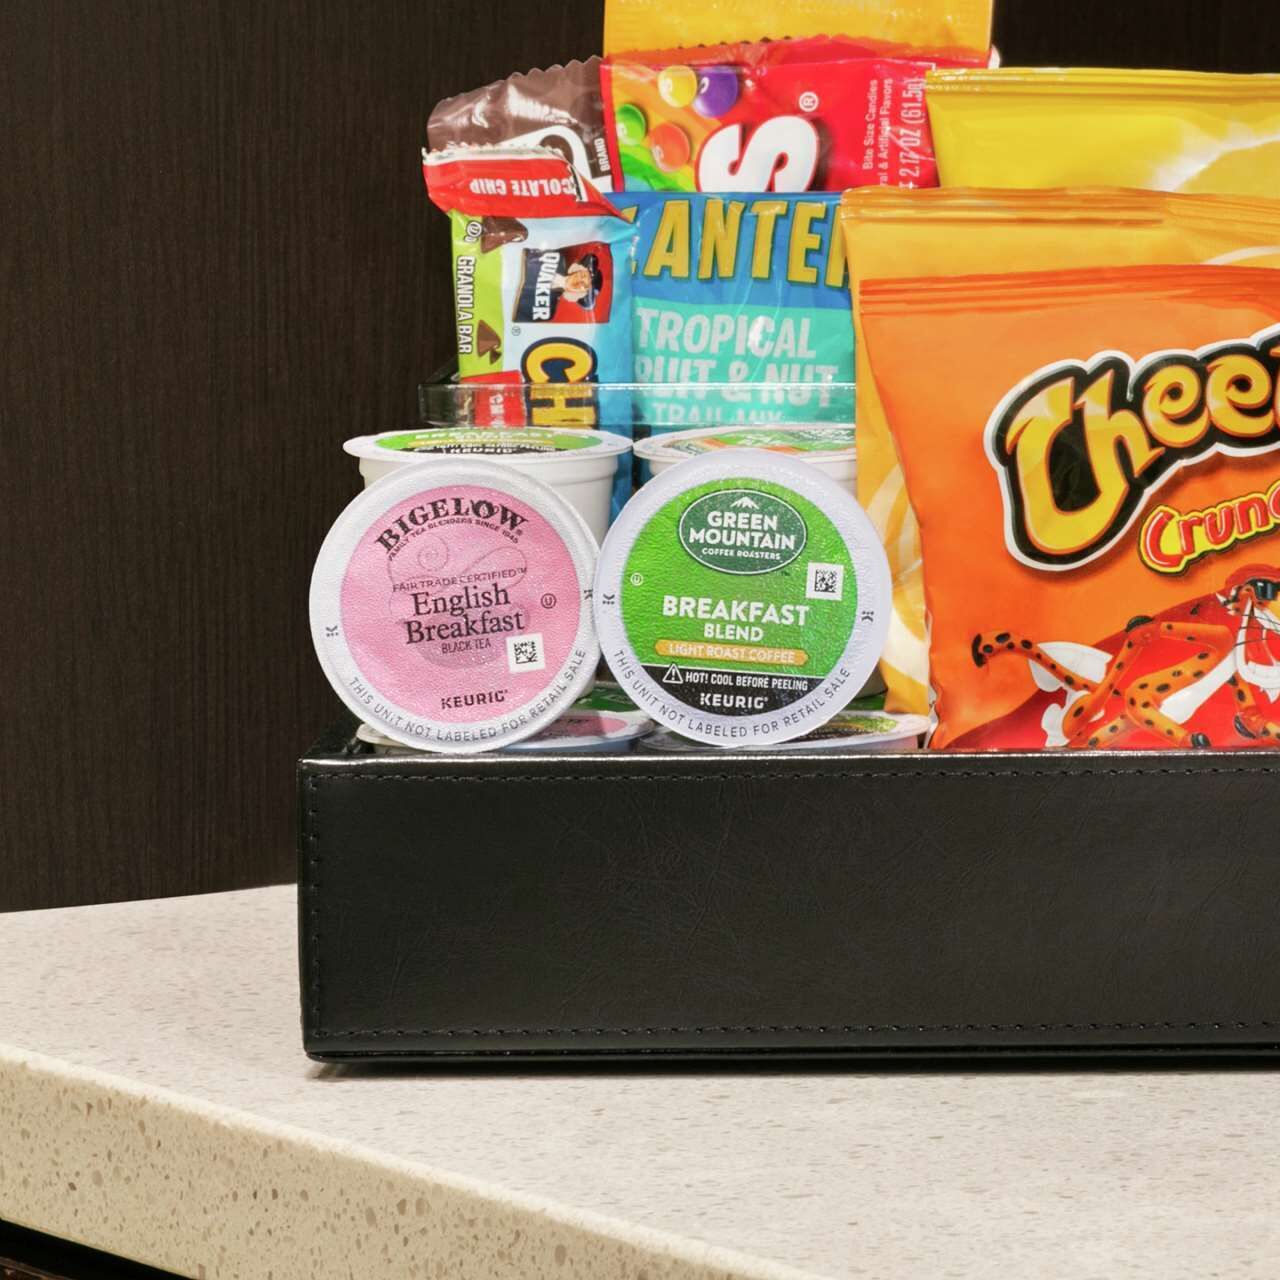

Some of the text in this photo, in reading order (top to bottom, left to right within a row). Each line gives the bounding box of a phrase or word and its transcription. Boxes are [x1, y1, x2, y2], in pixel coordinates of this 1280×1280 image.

[880, 79, 893, 114] Flavors
[862, 80, 878, 170] Bite Size Candies
[594, 138, 611, 172] BRAND
[469, 178, 575, 197] COLATE CHIP
[532, 252, 561, 320] QUAKER
[456, 256, 477, 354] GRANOLA BAR
[635, 307, 817, 359] TROPICAL
[635, 355, 839, 409] RUIT & NUT
[375, 497, 528, 553] BIGELOW
[475, 520, 499, 531] SINCE
[707, 510, 778, 531] GREEN
[688, 527, 796, 550] MOUNTAIN
[702, 547, 782, 561] COFFEE ROASTERS
[393, 582, 418, 593] FAIR
[421, 577, 458, 589] TRADE
[410, 583, 511, 618] English
[662, 595, 811, 627] BREAKFAST
[404, 611, 525, 645] Breakfast
[704, 623, 764, 642] BLEND
[441, 638, 492, 655] BLACK TEA
[669, 644, 796, 663] LIGHT ROAST COFFEE
[349, 677, 372, 706] THIS
[374, 705, 404, 728] UNIT
[404, 721, 432, 739] NOT
[436, 727, 497, 742] LABELED
[502, 714, 528, 735] FOR
[530, 683, 568, 719] RETAIL
[565, 648, 586, 681] SALE
[613, 650, 633, 680] THIS
[632, 680, 658, 707] UNIT
[659, 704, 684, 725] NOT
[688, 718, 748, 738] LABELED
[753, 721, 780, 736] FOR
[783, 696, 825, 726] RETAIL
[825, 667, 850, 699] SALE
[686, 672, 809, 691] HOT! COOL BEFORE PEELING
[441, 690, 505, 711] KEURIG
[700, 692, 764, 709] KEURIG
